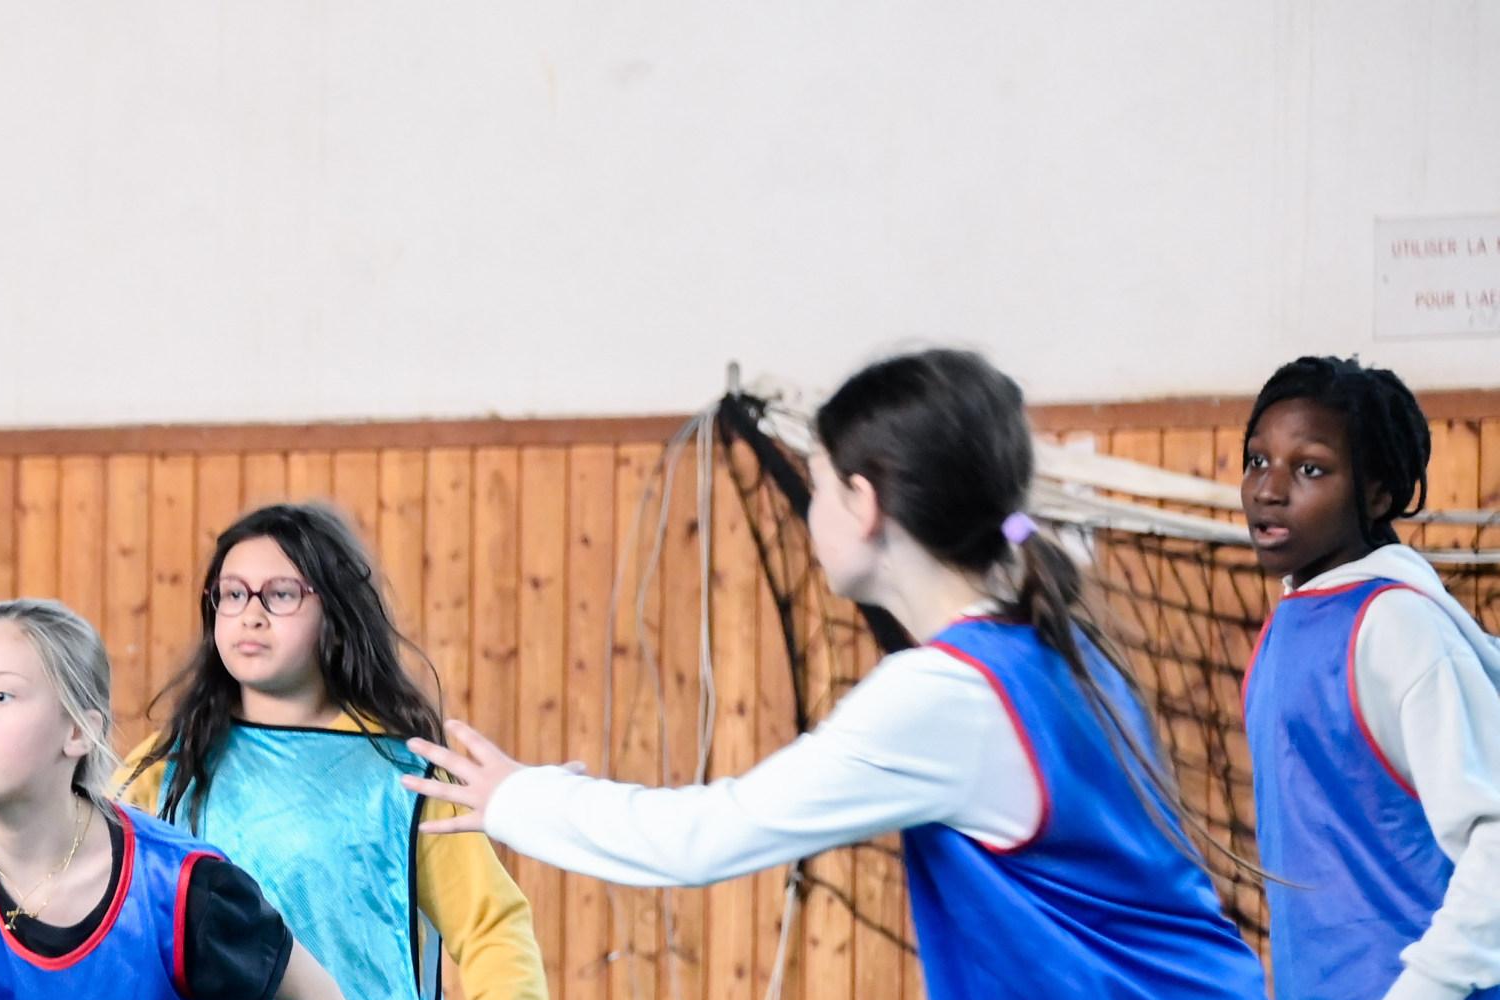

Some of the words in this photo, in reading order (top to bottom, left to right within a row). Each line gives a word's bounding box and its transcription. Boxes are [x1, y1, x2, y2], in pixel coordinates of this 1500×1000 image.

[1390, 238, 1457, 258] UTILISER
[1466, 236, 1487, 256] LA
[1414, 289, 1455, 309] POUR
